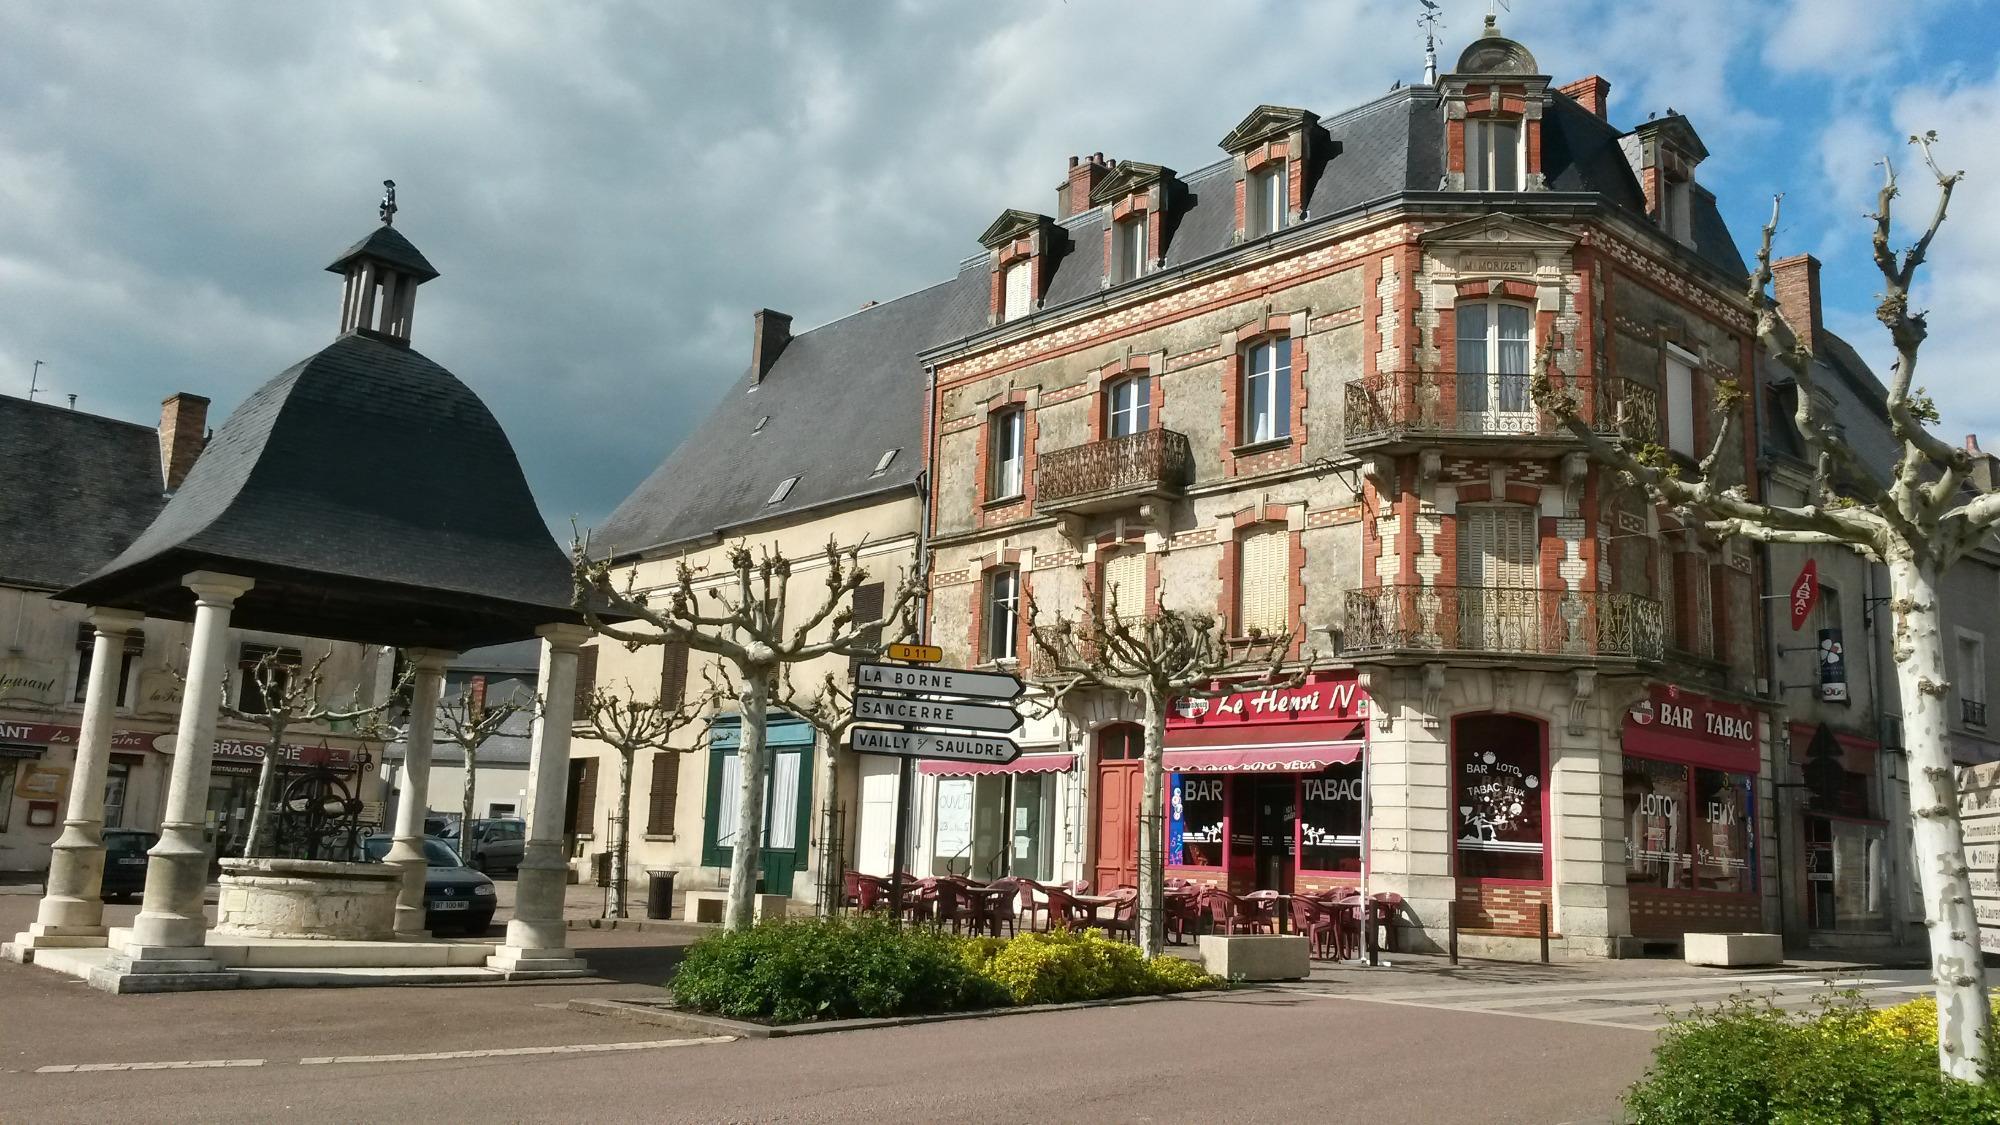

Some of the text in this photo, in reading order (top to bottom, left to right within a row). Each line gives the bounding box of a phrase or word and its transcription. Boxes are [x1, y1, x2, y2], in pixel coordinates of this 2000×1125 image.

[1478, 261, 1525, 271] MORIZET
[1795, 574, 1812, 615] TABAC
[904, 648, 927, 658] D 11
[864, 670, 953, 688] LA BORNE
[862, 702, 954, 720] SANCERRE
[1216, 696, 1244, 716] Le
[1250, 690, 1319, 714] Henri
[1660, 703, 1753, 741] BAR TABAC
[859, 734, 910, 749] VAILLY
[935, 740, 1004, 757] SAULDRE
[1466, 762, 1520, 775] BAR LOTO
[1185, 778, 1363, 801] BAR TABAC
[1467, 783, 1525, 797] TABAC JEUX
[1640, 792, 1736, 826] LOTO JEUX
[1978, 850, 1995, 864] Office
